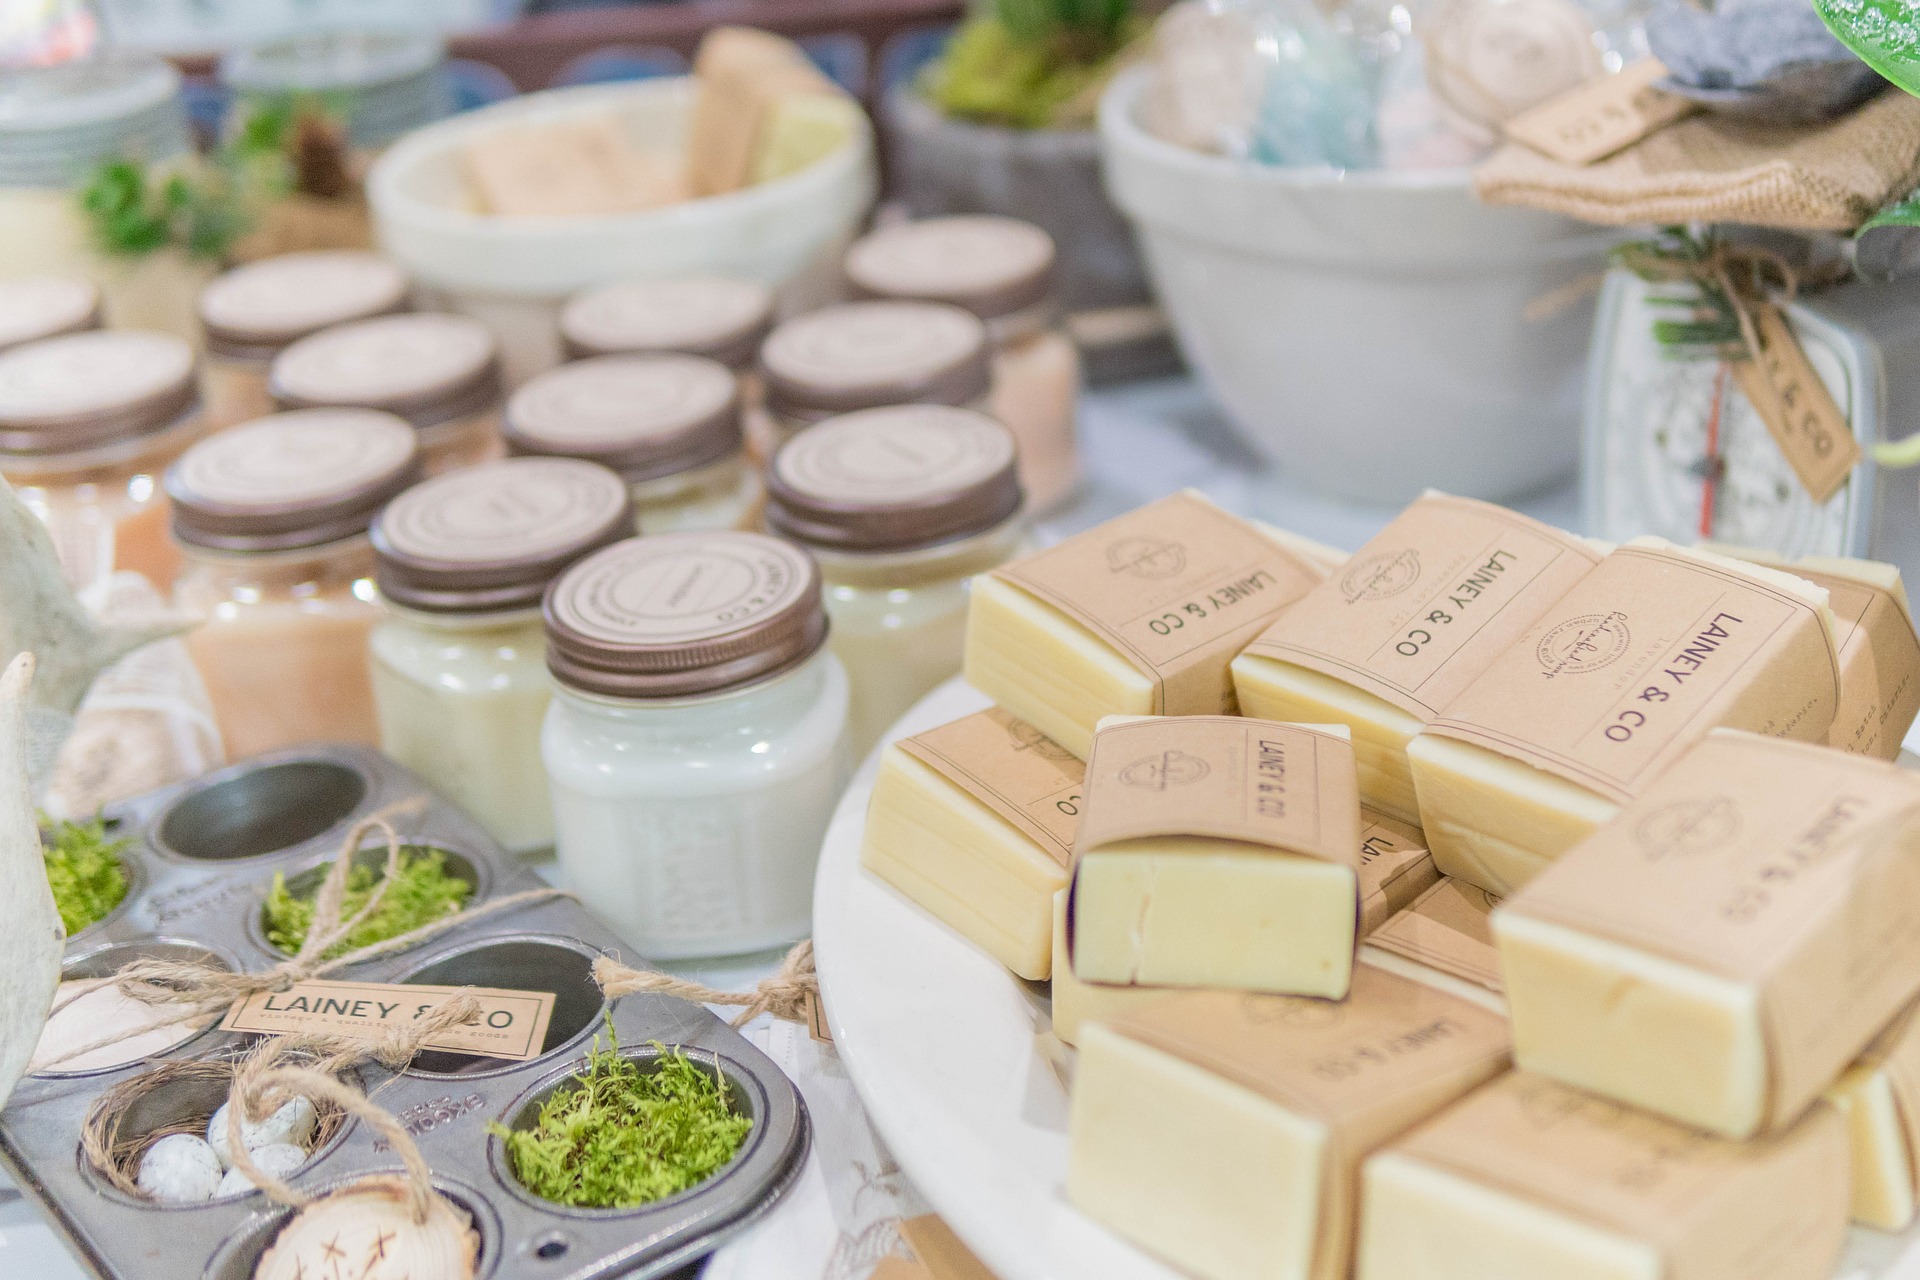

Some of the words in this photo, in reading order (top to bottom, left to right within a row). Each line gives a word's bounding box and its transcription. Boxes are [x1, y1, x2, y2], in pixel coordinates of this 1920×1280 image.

[1207, 570, 1277, 611] LAINEY
[1448, 550, 1518, 610] LAINEY
[1181, 603, 1207, 618] &
[1424, 610, 1453, 624] &
[1149, 613, 1185, 636] CO
[1396, 629, 1432, 657] CO
[1664, 612, 1743, 684] LAINEY
[1637, 686, 1670, 702] &
[1605, 710, 1647, 743] CO
[1259, 740, 1285, 782] LAINEY
[263, 995, 400, 1019] LAINEY
[470, 1031, 509, 1040] goods
